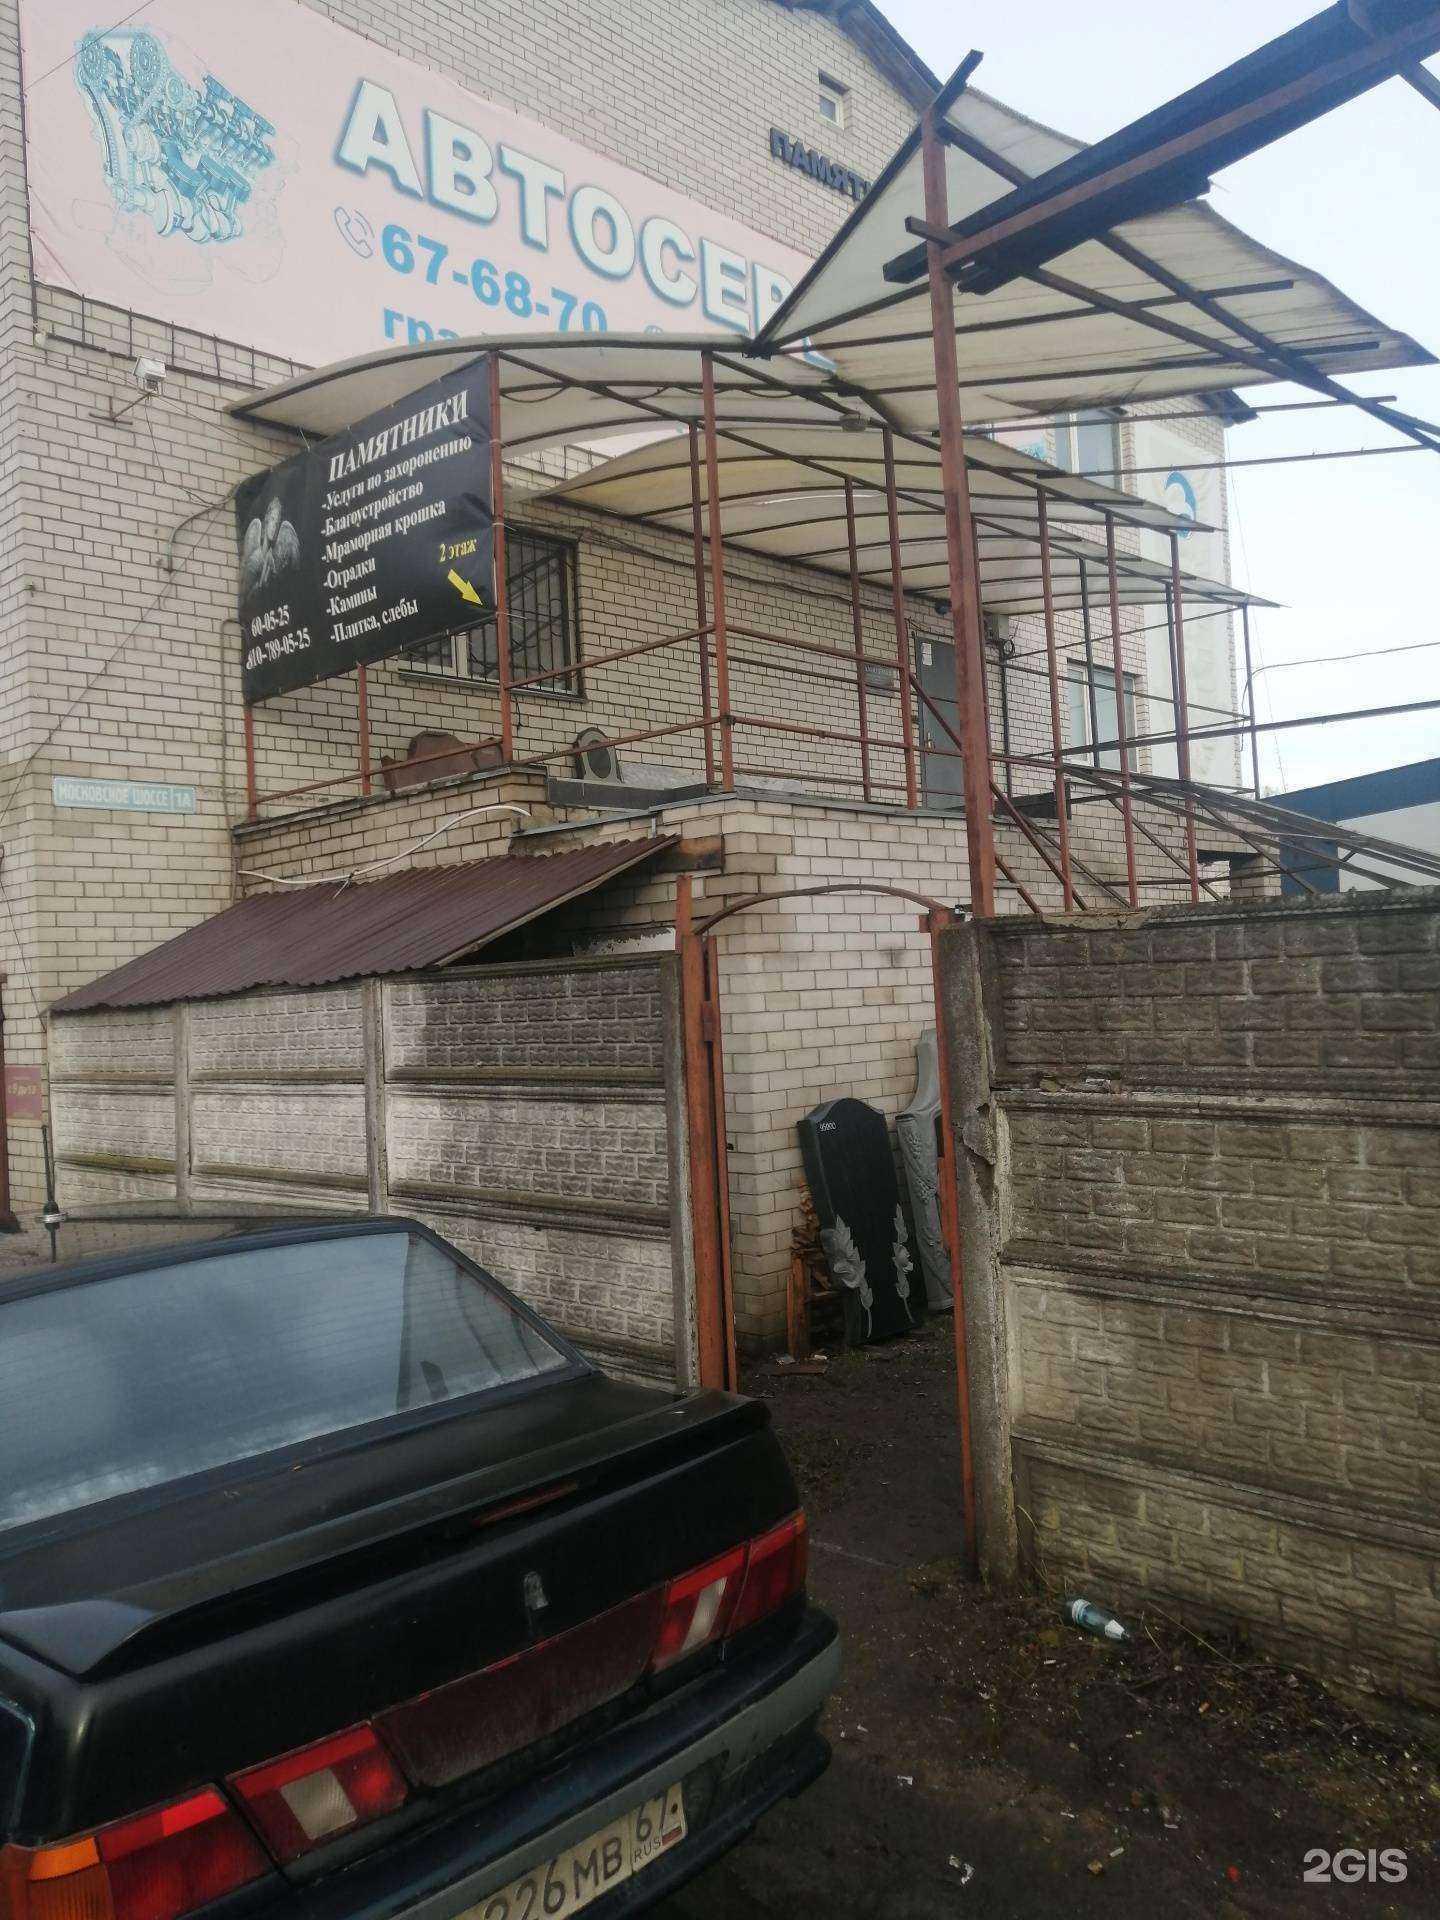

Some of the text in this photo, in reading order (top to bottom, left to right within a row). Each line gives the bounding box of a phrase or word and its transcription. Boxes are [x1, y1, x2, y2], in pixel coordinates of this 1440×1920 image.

[335, 79, 796, 342] АВТОСЕР
[381, 224, 608, 335] 67-68-70
[328, 390, 469, 482] ПАМЯТНИКИ
[321, 436, 472, 510] -Услуги по захоронению
[321, 481, 423, 536] -Благоустройство
[321, 500, 446, 562] -Мраморная крошка
[323, 558, 376, 589] -Оградки
[440, 539, 477, 562] 2 этаж
[326, 586, 378, 616] -Камины
[330, 598, 419, 642] -Плитка, слебы
[57, 783, 129, 804] МОСКОВСКОЕ
[132, 785, 169, 807] ШОССЕ
[634, 1837, 662, 1864] RUS
